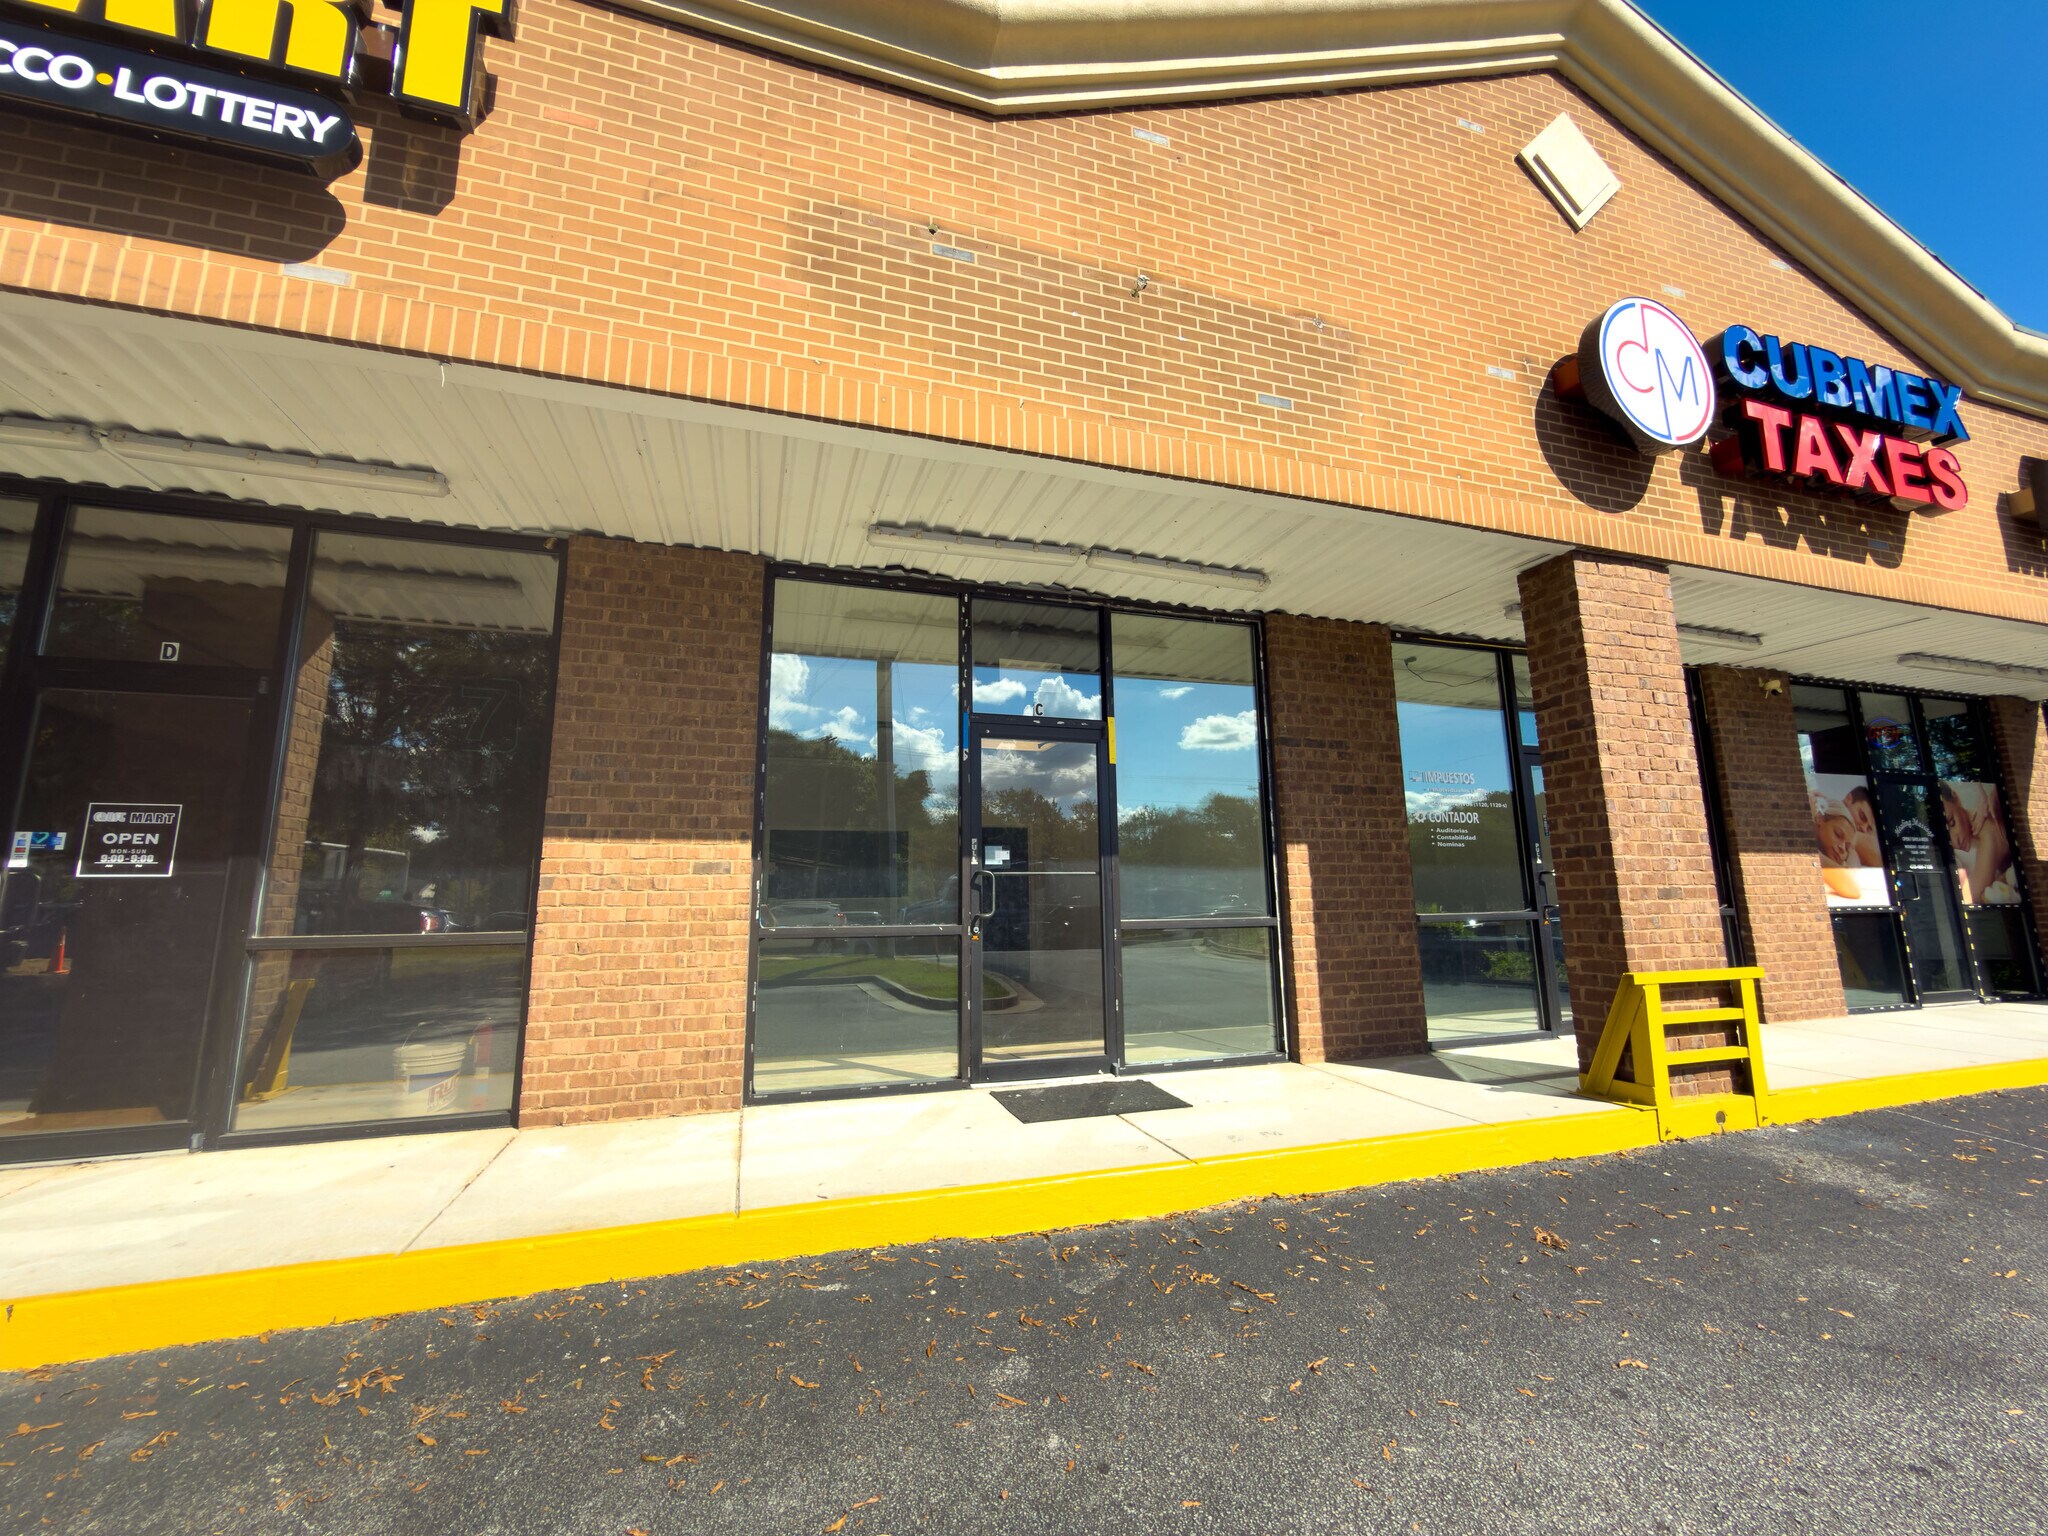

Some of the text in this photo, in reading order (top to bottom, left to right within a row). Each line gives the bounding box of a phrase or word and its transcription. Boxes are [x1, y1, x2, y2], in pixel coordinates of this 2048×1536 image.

[113, 67, 340, 144] LOTTERY
[1722, 325, 1968, 438] CUBMEX
[1742, 400, 1969, 512] TAXES
[161, 644, 177, 660] D
[130, 812, 176, 824] MART
[1429, 811, 1480, 824] CONTADOR
[102, 832, 160, 845] OPEN
